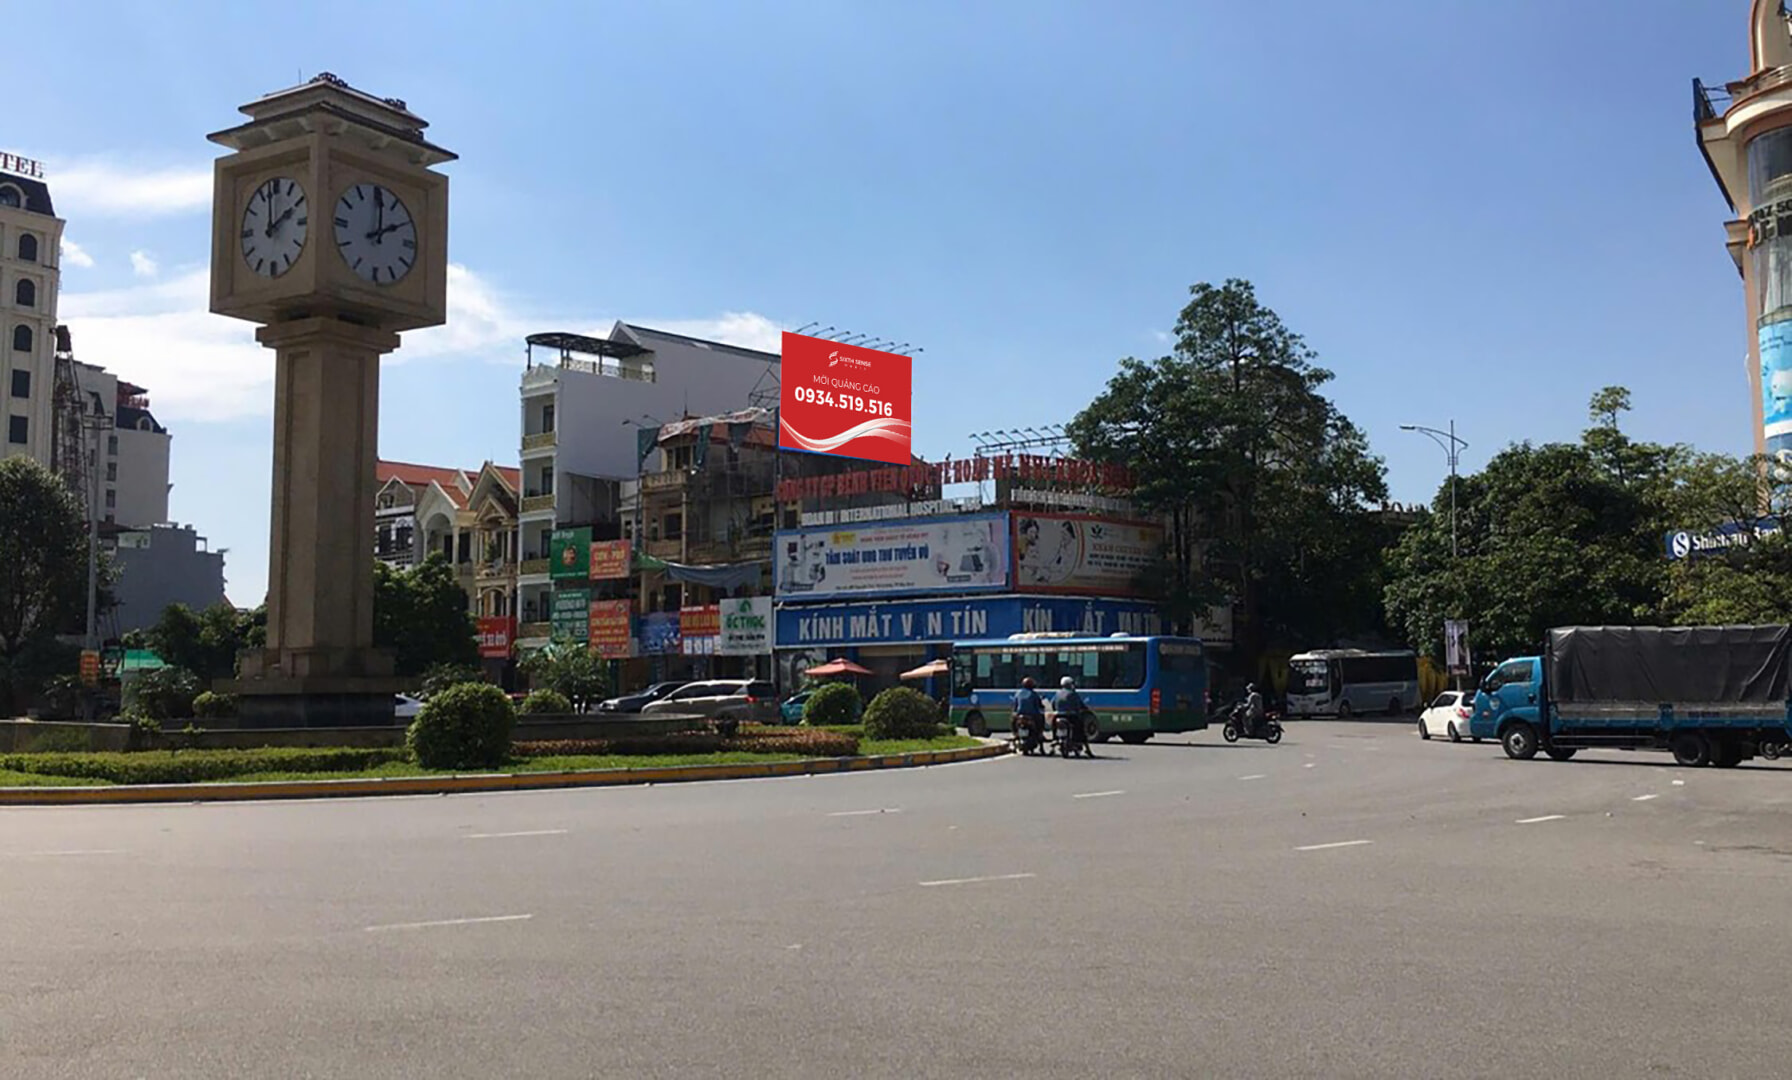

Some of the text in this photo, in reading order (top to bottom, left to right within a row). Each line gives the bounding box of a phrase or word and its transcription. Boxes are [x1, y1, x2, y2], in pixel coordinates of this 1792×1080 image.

[855, 358, 871, 368] SENSE
[862, 384, 880, 395] CÁO
[794, 386, 893, 417] 0934.519.516
[799, 612, 844, 641] KÍNH
[850, 605, 893, 638] MẮT
[951, 605, 987, 636] TÍN
